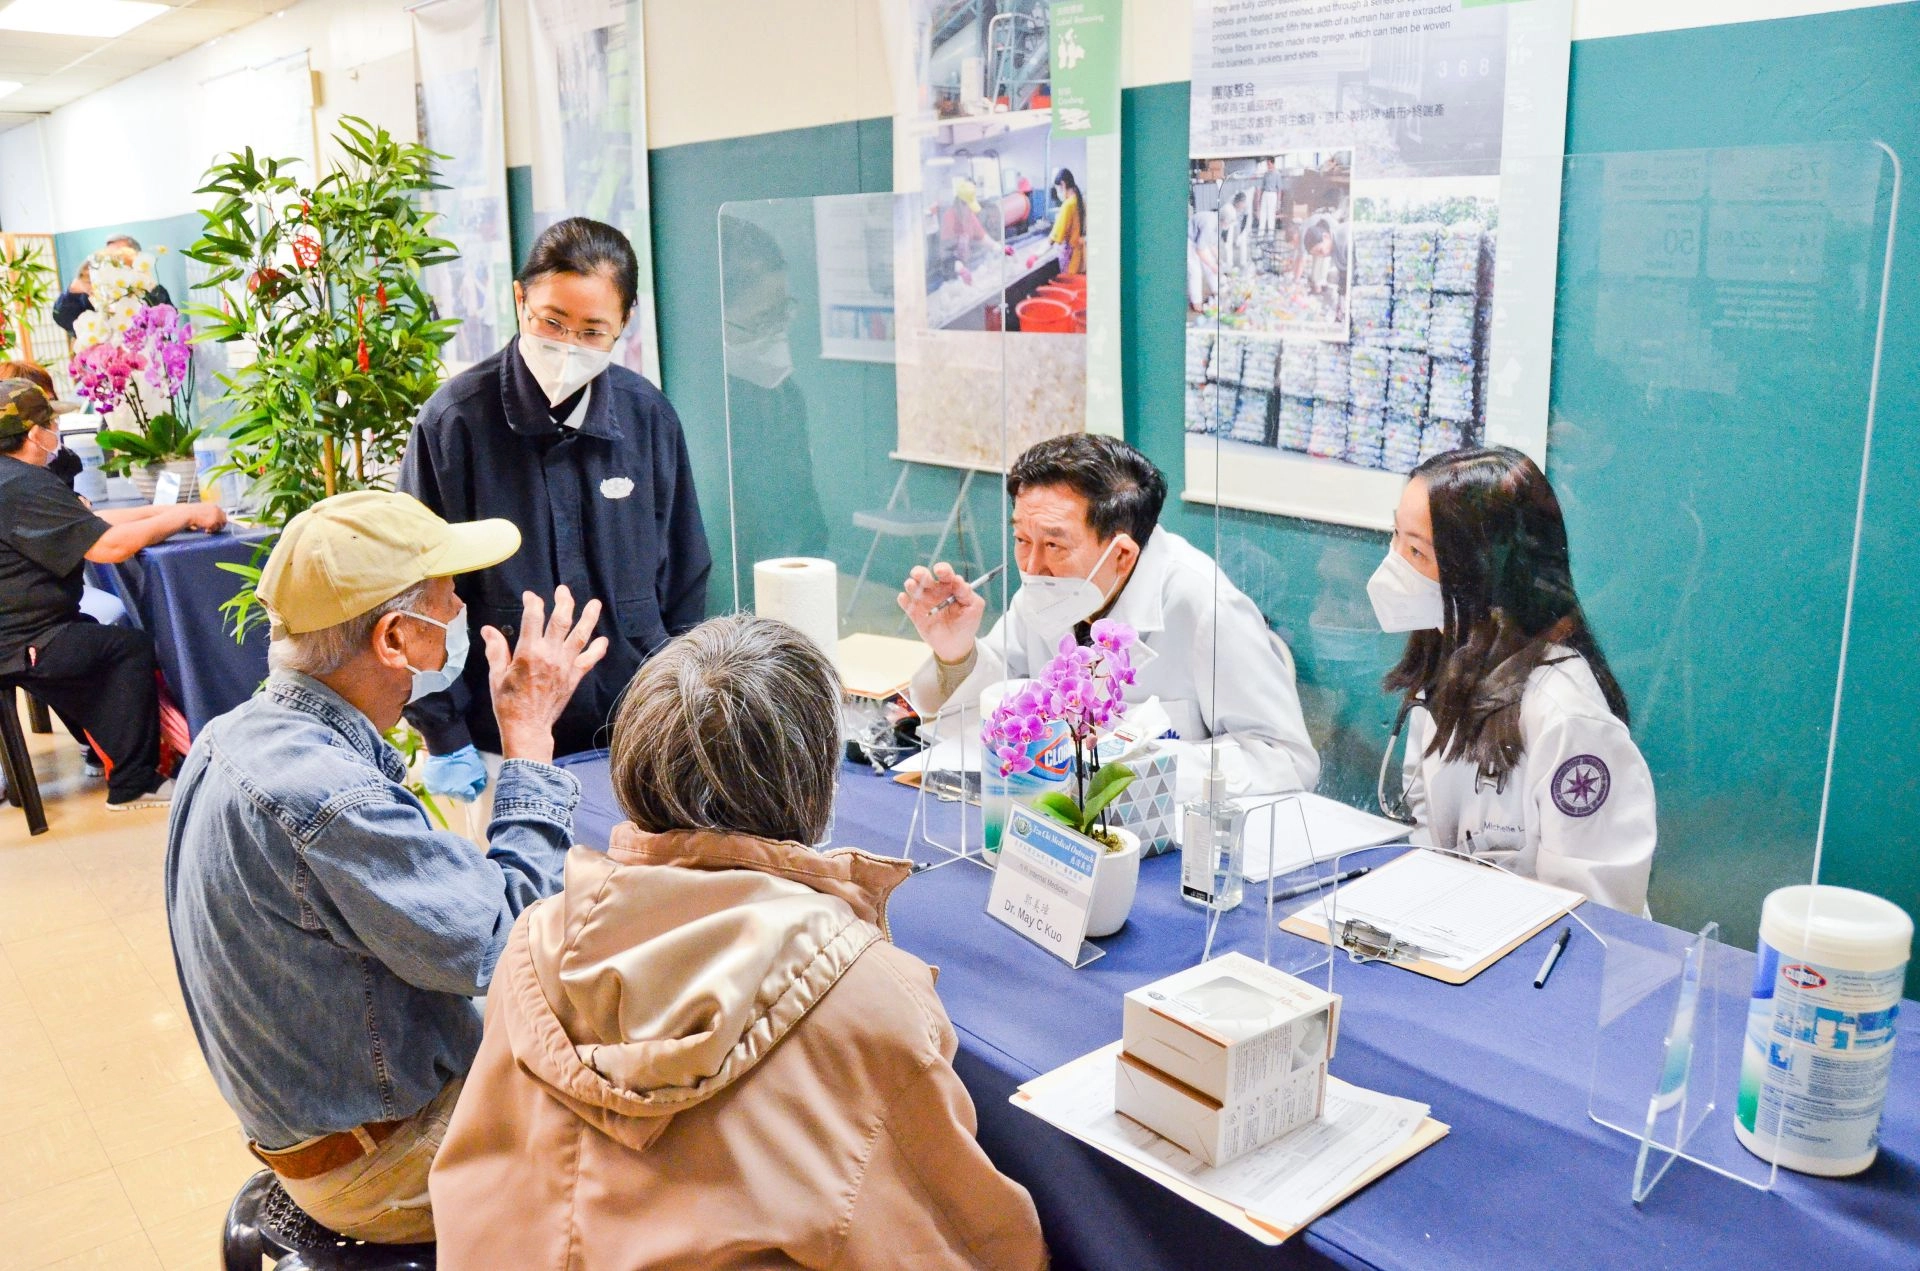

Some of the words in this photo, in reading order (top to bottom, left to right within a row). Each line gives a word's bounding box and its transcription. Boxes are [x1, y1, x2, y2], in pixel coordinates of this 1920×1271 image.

[1271, 26, 1285, 34] one
[1300, 21, 1312, 30] the
[1314, 19, 1333, 28] width
[1335, 18, 1343, 26] of
[1344, 17, 1349, 25] a
[1351, 14, 1378, 24] human
[1380, 10, 1395, 20] hair
[1397, 10, 1411, 18] are
[1412, 3, 1453, 16] extracted.
[1275, 10, 1288, 19] and
[1317, 5, 1331, 13] and
[1332, 0, 1362, 11] through
[1212, 46, 1233, 54] These
[1255, 42, 1267, 50] are
[1268, 40, 1284, 48] then
[1285, 37, 1305, 46] made
[1307, 35, 1320, 43] into
[1349, 29, 1371, 39] which
[1373, 28, 1388, 36] can
[1390, 24, 1408, 34] then
[1410, 23, 1421, 32] be
[1423, 20, 1451, 31] woven
[1284, 52, 1297, 61] and
[1051, 833, 1071, 851] Medical
[1047, 876, 1069, 897] Medicine
[1004, 899, 1016, 915] Dr.
[1018, 910, 1035, 928] May
[1036, 918, 1043, 931] C
[1044, 922, 1063, 943] Kuo
